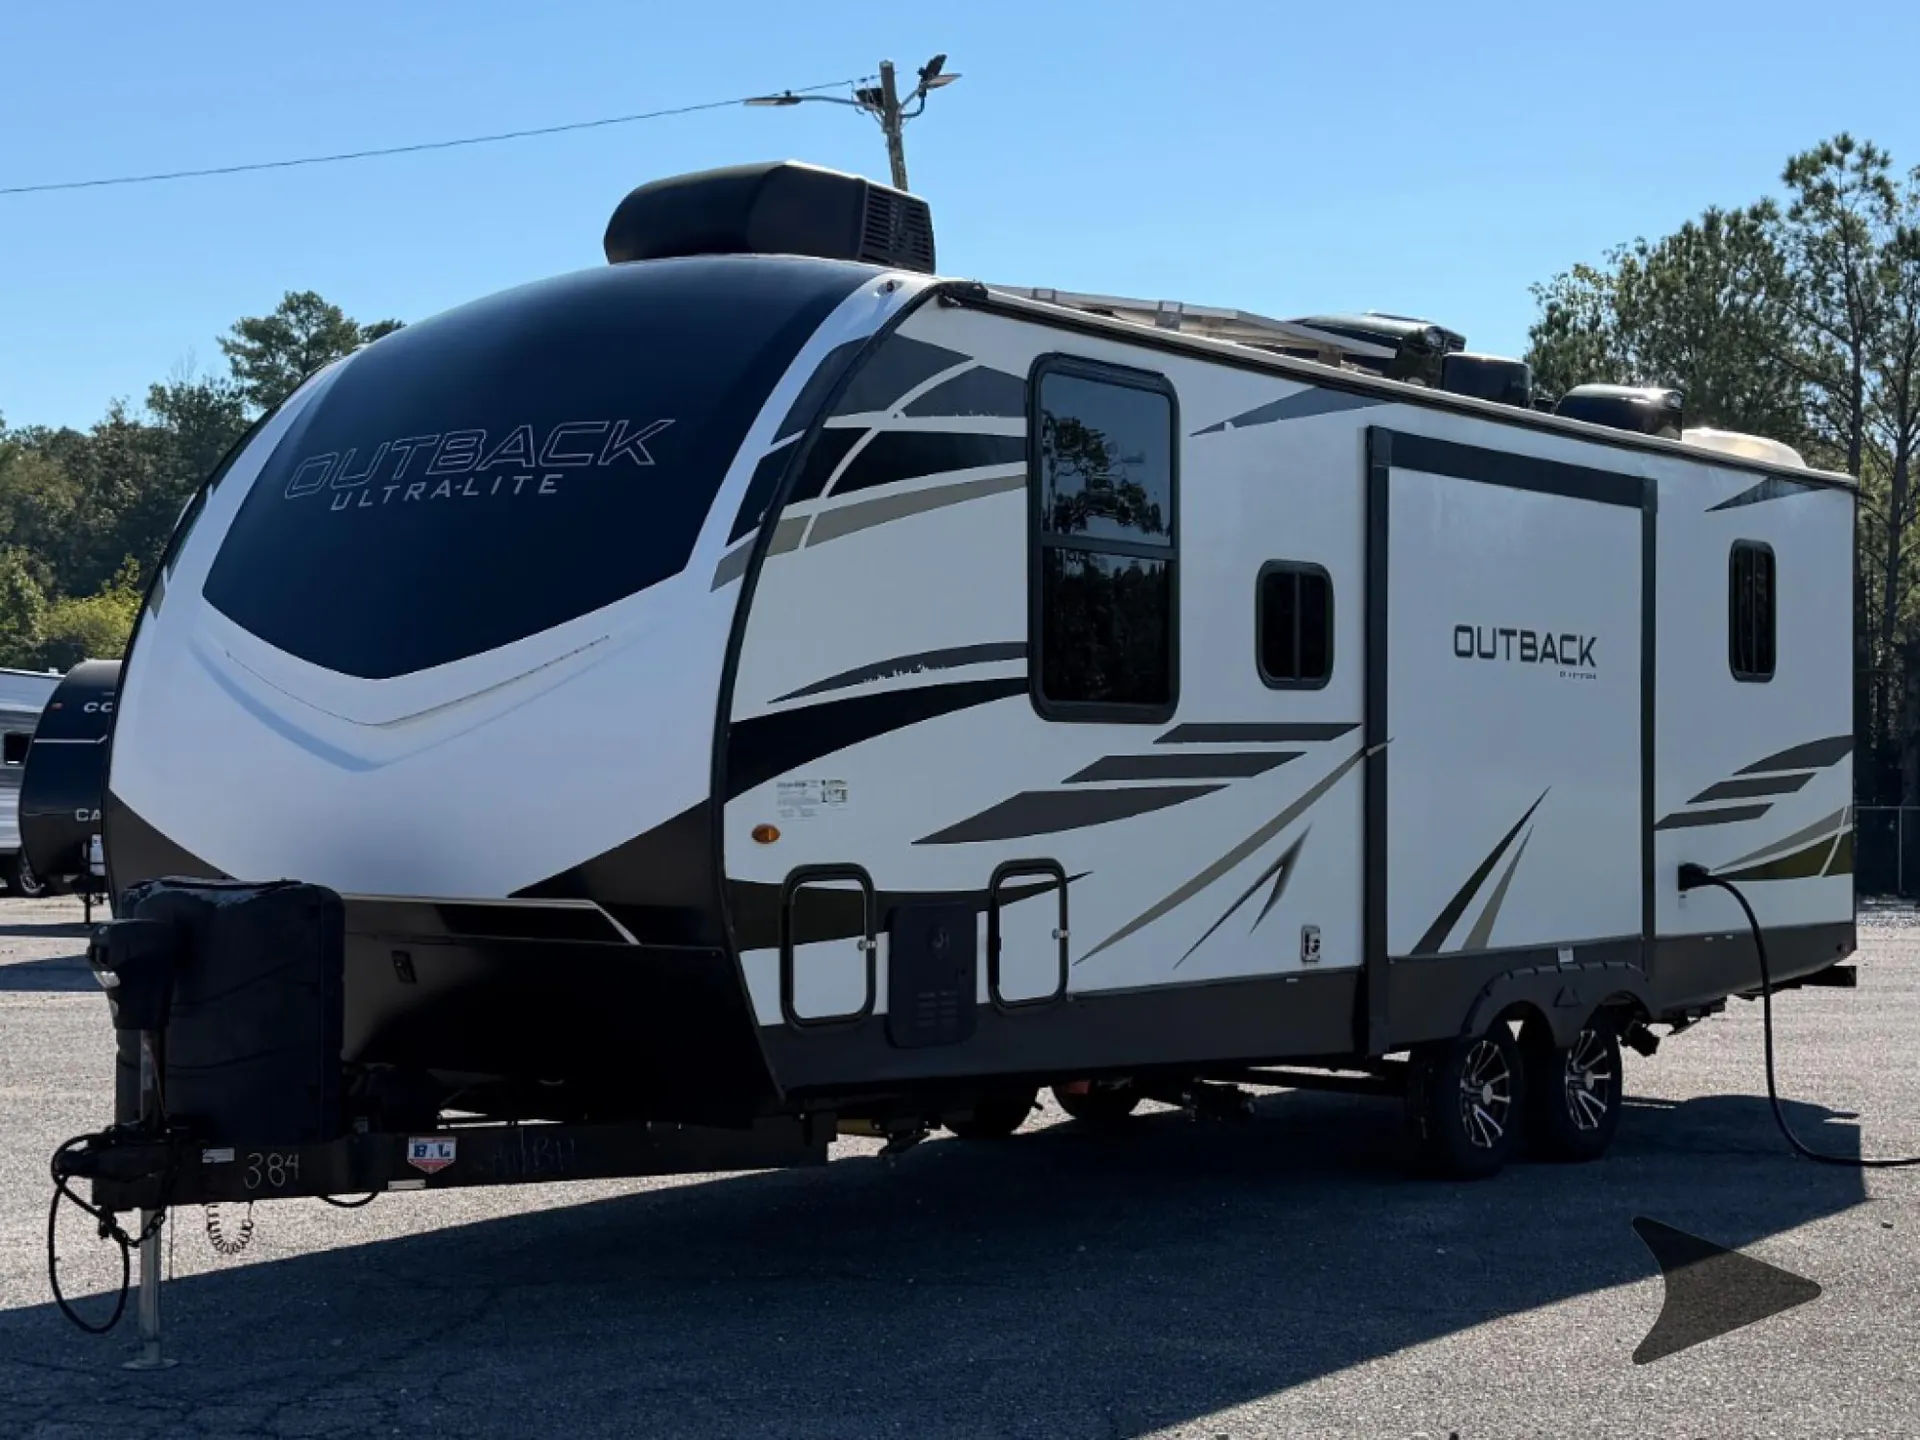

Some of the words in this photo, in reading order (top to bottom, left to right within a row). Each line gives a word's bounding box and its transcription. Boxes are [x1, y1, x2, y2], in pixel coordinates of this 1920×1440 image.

[285, 419, 676, 499] OUTBACK
[330, 473, 564, 510] ULTRA-LITE
[1454, 623, 1598, 669] OUTBACK
[244, 1152, 300, 1190] 384
